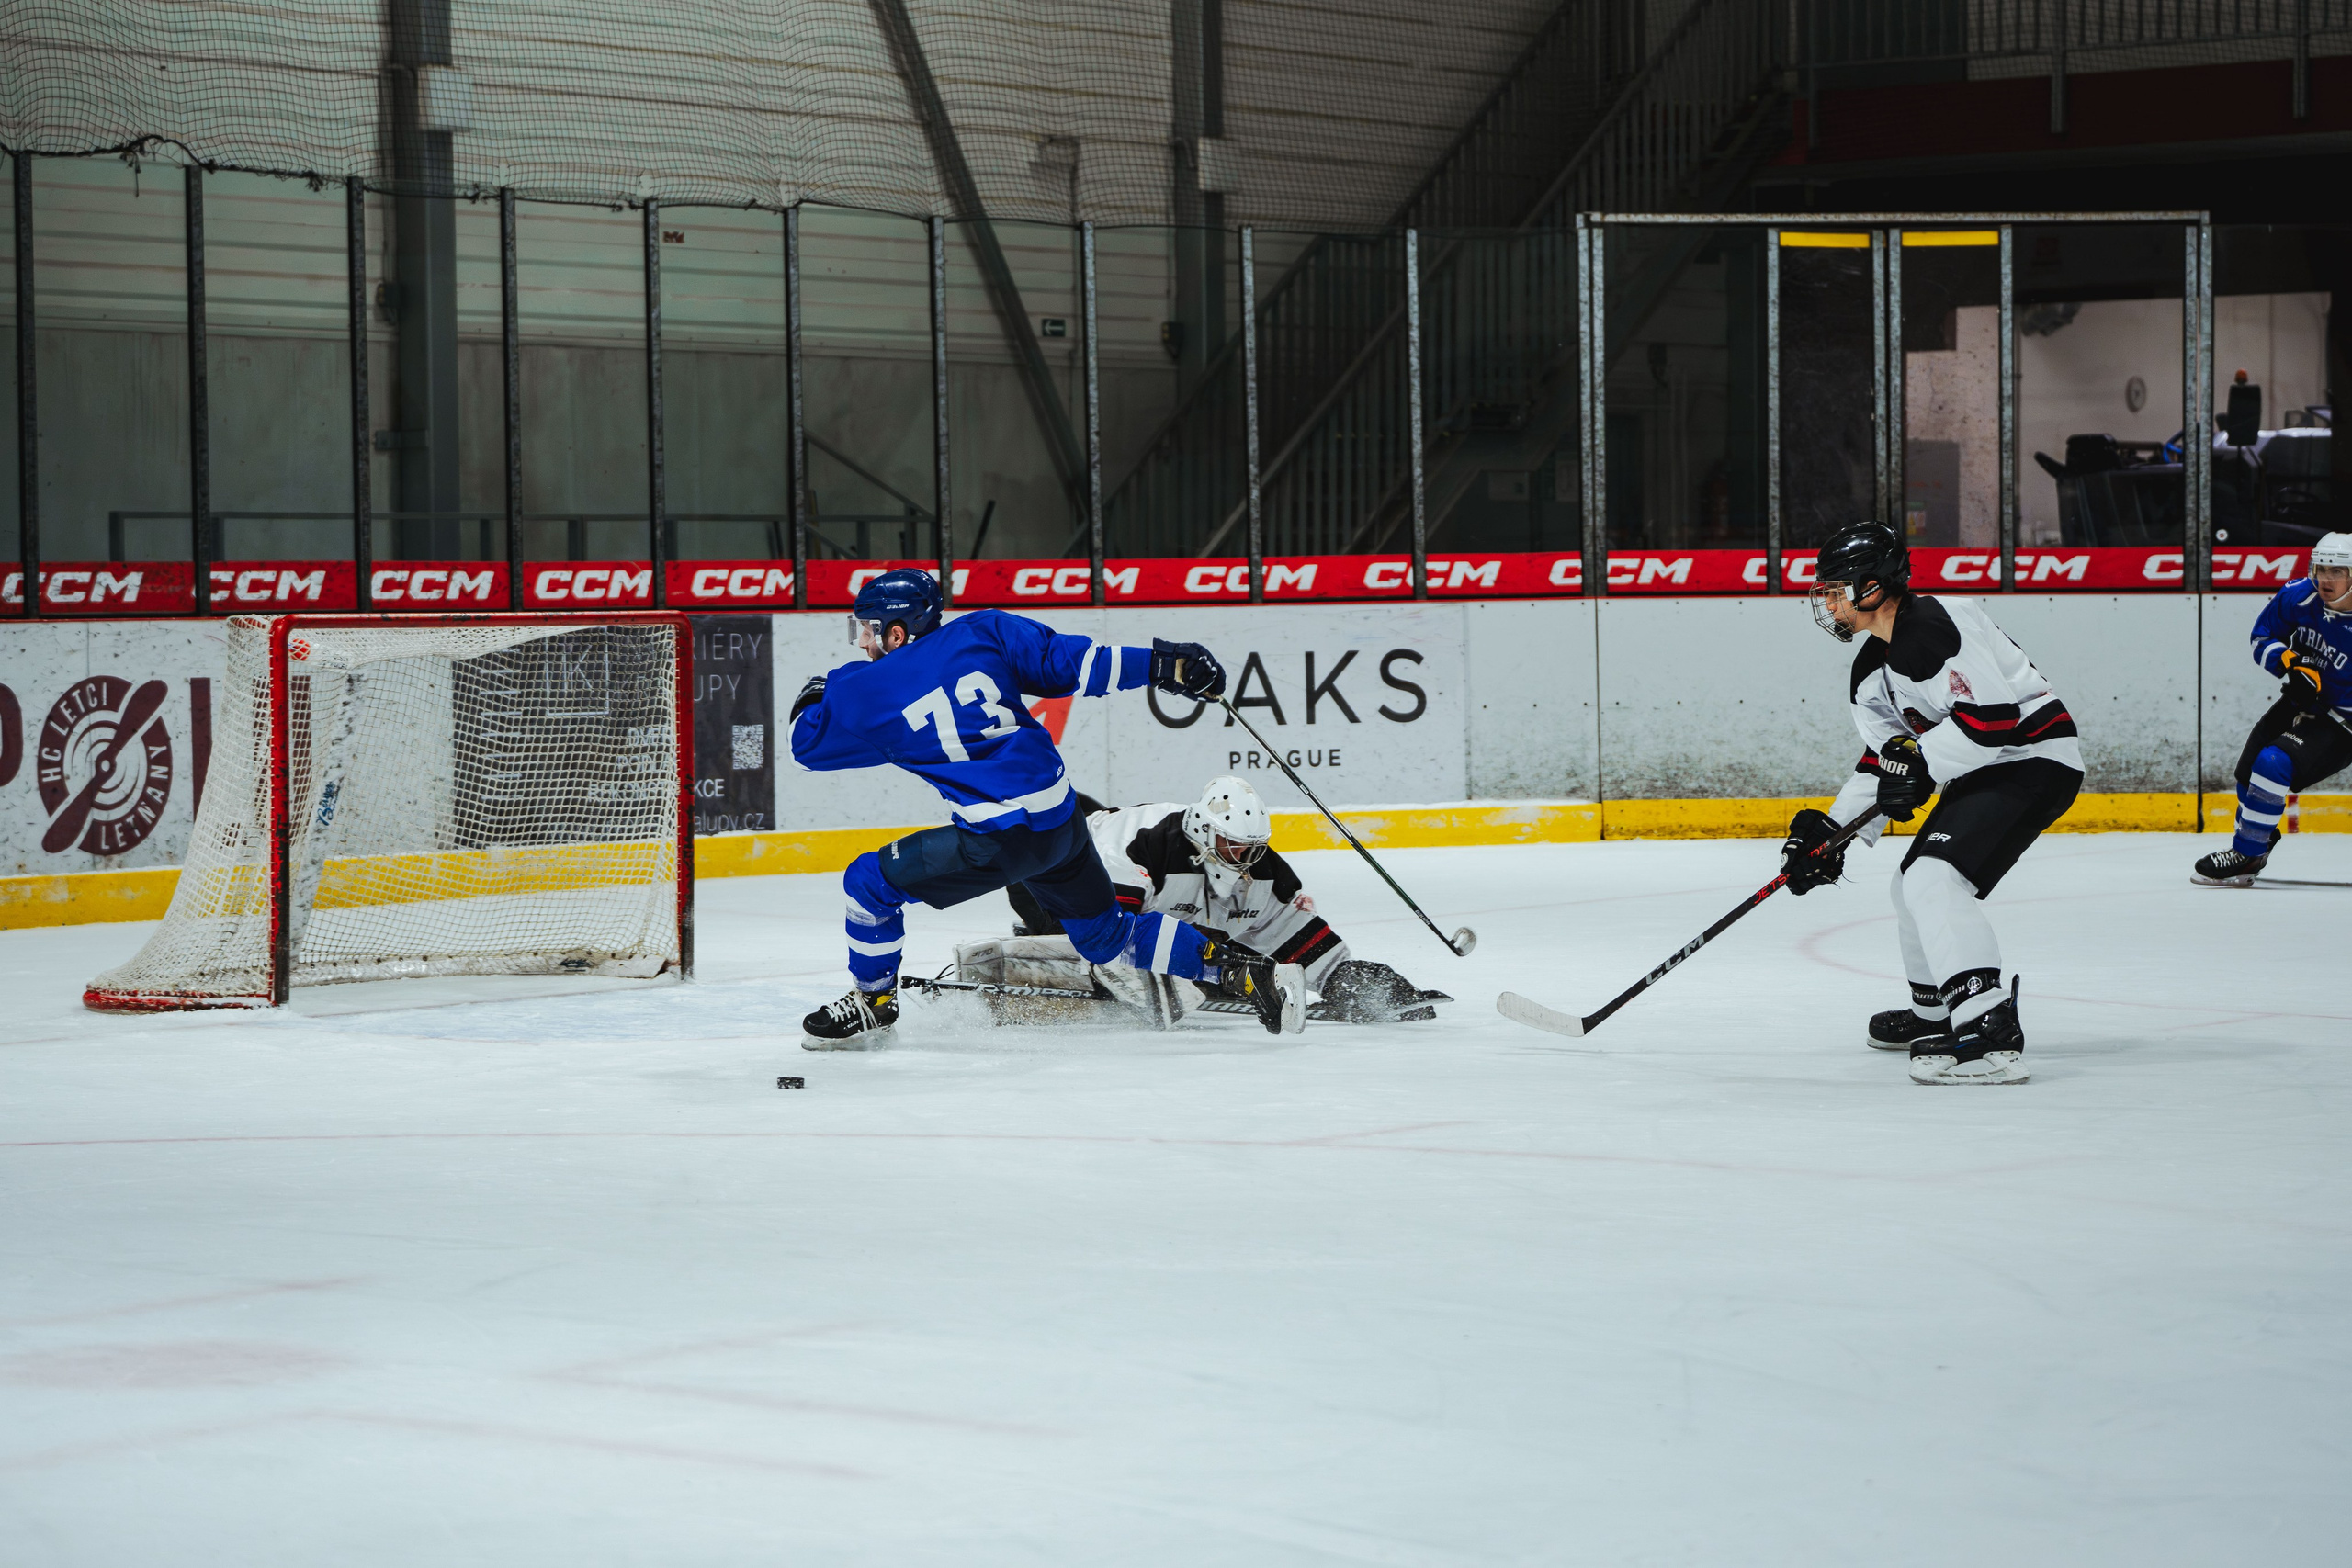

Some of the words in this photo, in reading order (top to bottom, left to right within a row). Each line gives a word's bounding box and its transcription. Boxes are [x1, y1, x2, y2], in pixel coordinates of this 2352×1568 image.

[1012, 566, 1140, 596] CCM
[1183, 563, 1318, 593] CCM
[1363, 560, 1502, 589] CCM
[1549, 558, 1693, 586] CCM
[1741, 557, 1818, 584] CC
[1940, 555, 2090, 581] CCM
[2143, 553, 2298, 581] CCM
[1, 571, 144, 603] CCM
[190, 570, 326, 601] CCM
[370, 570, 495, 601] CCM
[535, 570, 653, 599] CCM
[690, 568, 794, 598] CCM
[49, 682, 107, 736] LETCI
[901, 671, 1021, 763] 73
[41, 748, 62, 783] HC
[1645, 933, 1705, 985] CCM
